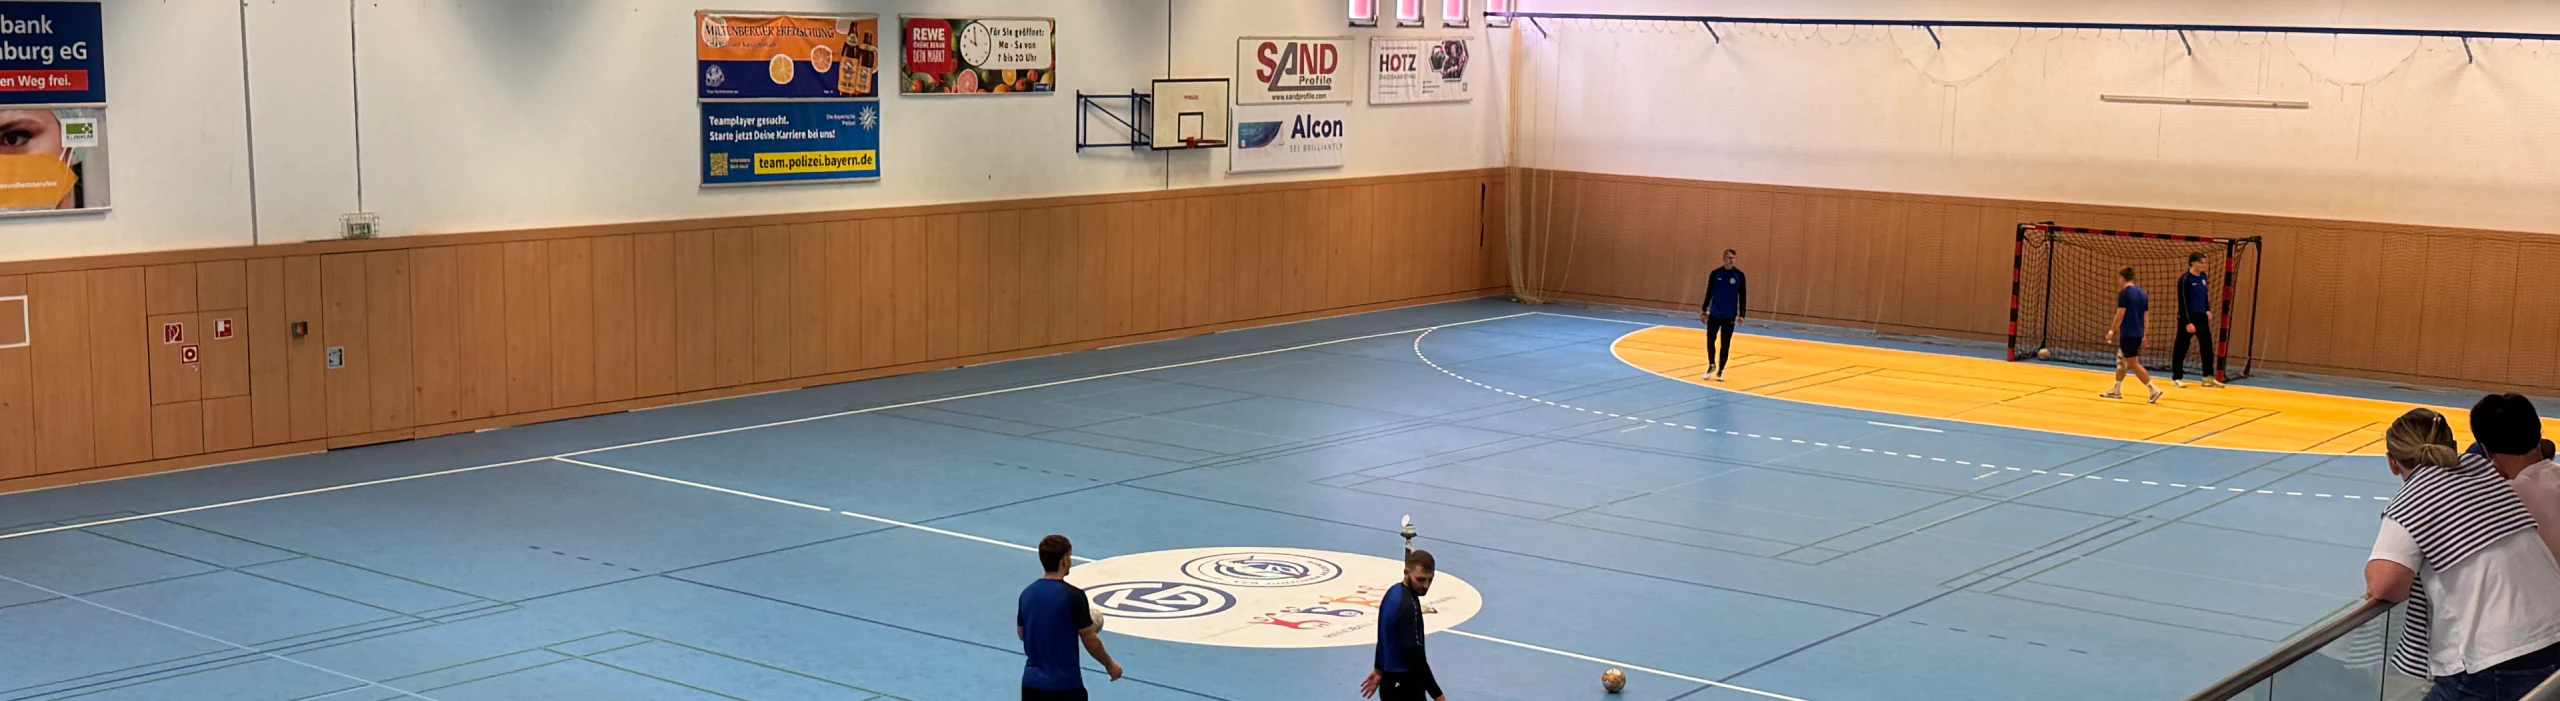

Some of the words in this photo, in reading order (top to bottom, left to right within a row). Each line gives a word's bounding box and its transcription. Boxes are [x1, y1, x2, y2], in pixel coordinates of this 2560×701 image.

[1, 14, 53, 34] bank
[913, 27, 945, 41] REWE
[990, 27, 1000, 37] Für
[1002, 27, 1014, 37] Sie
[1015, 27, 1045, 38] geöffnet:
[1014, 40, 1023, 49] Sa
[0, 40, 54, 65] burg
[60, 41, 87, 60] eG
[913, 49, 926, 63] DEIN
[927, 49, 945, 63] MARKT
[1003, 54, 1013, 62] bis
[1015, 54, 1024, 62] 20
[1025, 54, 1037, 62] Uhr
[1256, 41, 1339, 91] SAND
[1379, 53, 1417, 72] HOTZ
[18, 75, 46, 89] Weg
[48, 74, 71, 86] frei.
[1298, 76, 1332, 85] Profile
[1271, 92, 1327, 101] www.sandprofile.com
[709, 115, 755, 127] Teamplayer
[757, 115, 789, 127] gesucht.
[1290, 114, 1343, 138] Alcon
[709, 131, 734, 141] Starte
[735, 131, 753, 142] jetzt
[754, 130, 775, 140] Deine
[776, 130, 806, 140] Karriere
[807, 129, 819, 139] bei
[820, 129, 836, 139] uns!
[759, 153, 873, 170] team.polizei.bayern.de
